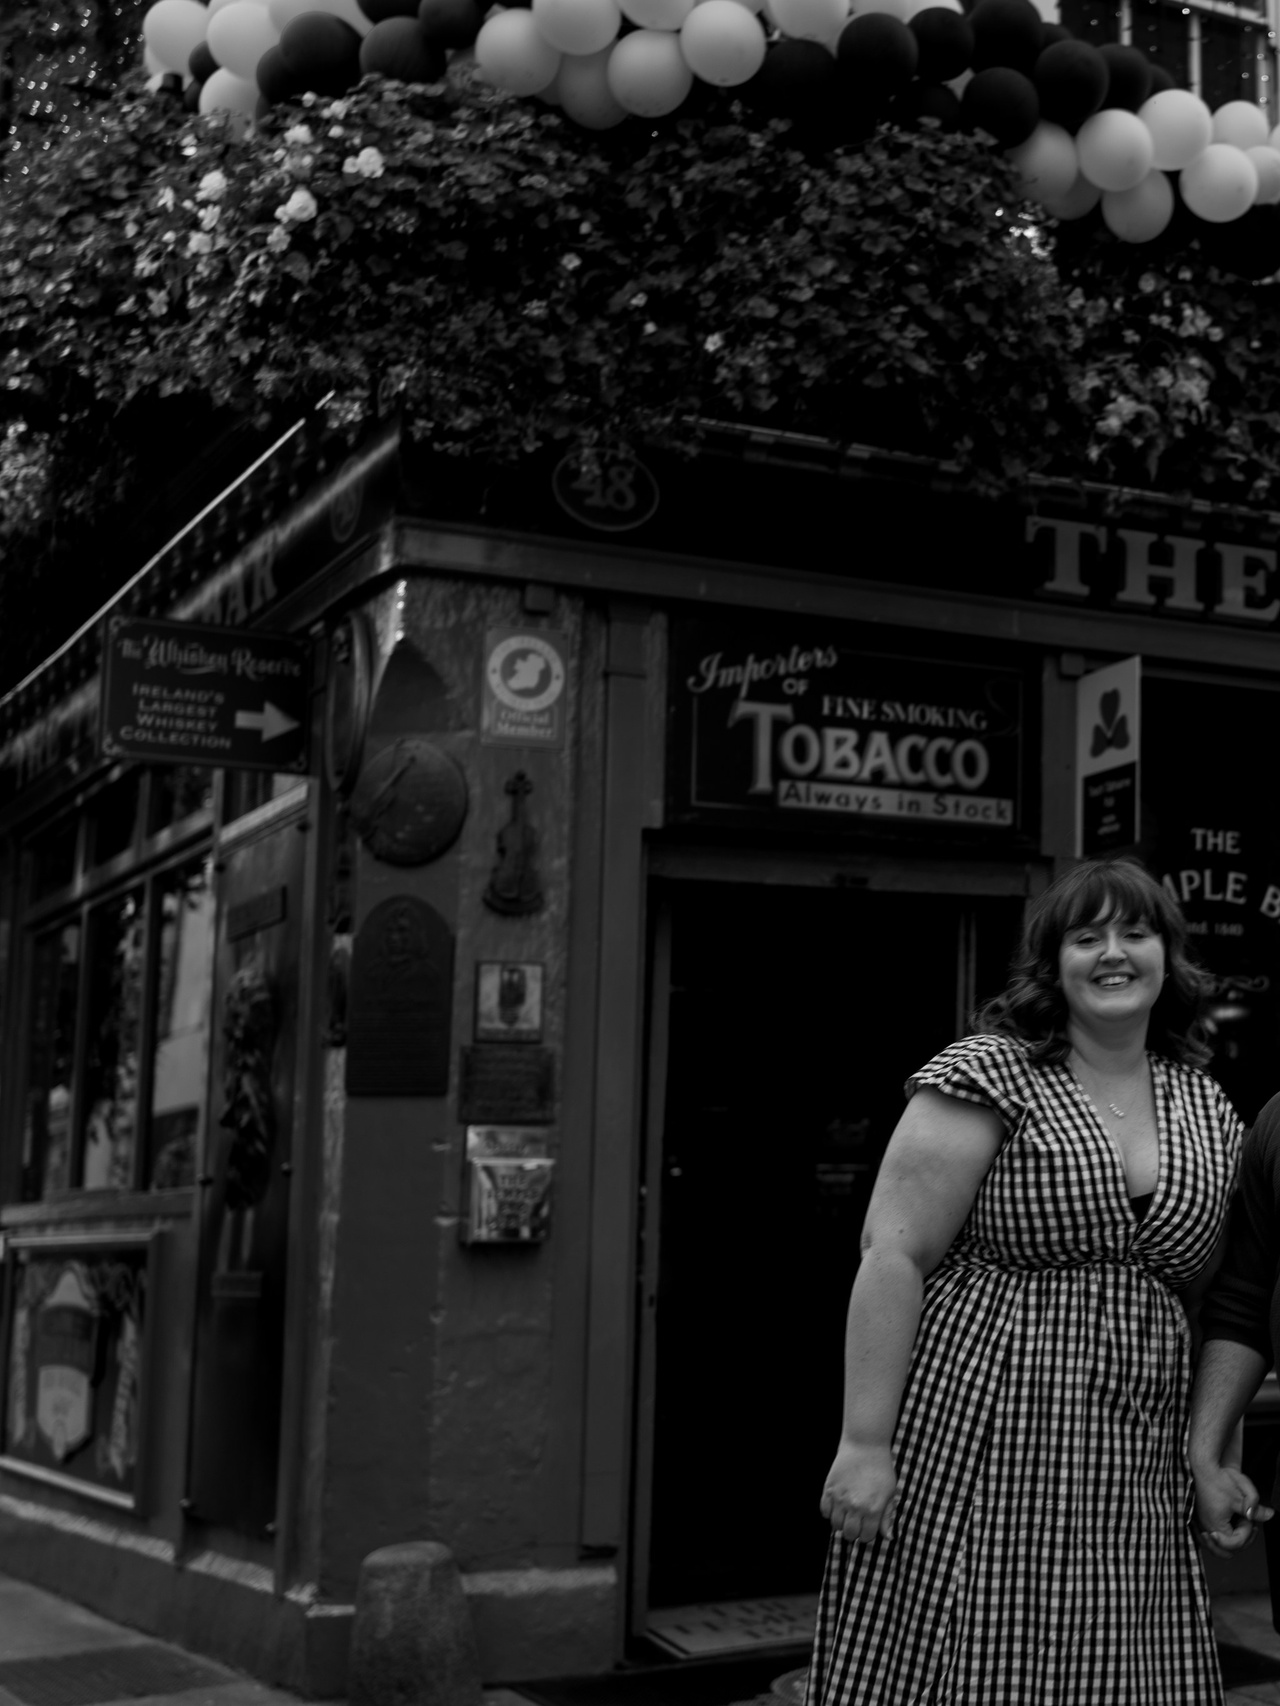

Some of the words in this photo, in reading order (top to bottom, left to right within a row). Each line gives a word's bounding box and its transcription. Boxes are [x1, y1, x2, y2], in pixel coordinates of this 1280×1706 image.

[142, 634, 229, 676] Whiskey
[230, 646, 302, 682] Reserve
[686, 644, 839, 700] Importers
[131, 681, 226, 705] IRELAND'S
[138, 699, 219, 718] LARGEST
[136, 713, 219, 733] WHISKEY
[821, 694, 877, 721] FINE
[880, 698, 989, 732] SMOKING
[119, 724, 232, 750] COLLECTION
[726, 699, 991, 796] TOBACCO
[783, 781, 882, 814] Always
[897, 789, 921, 815] in
[934, 792, 1009, 823] Stock
[1190, 826, 1242, 855] THE
